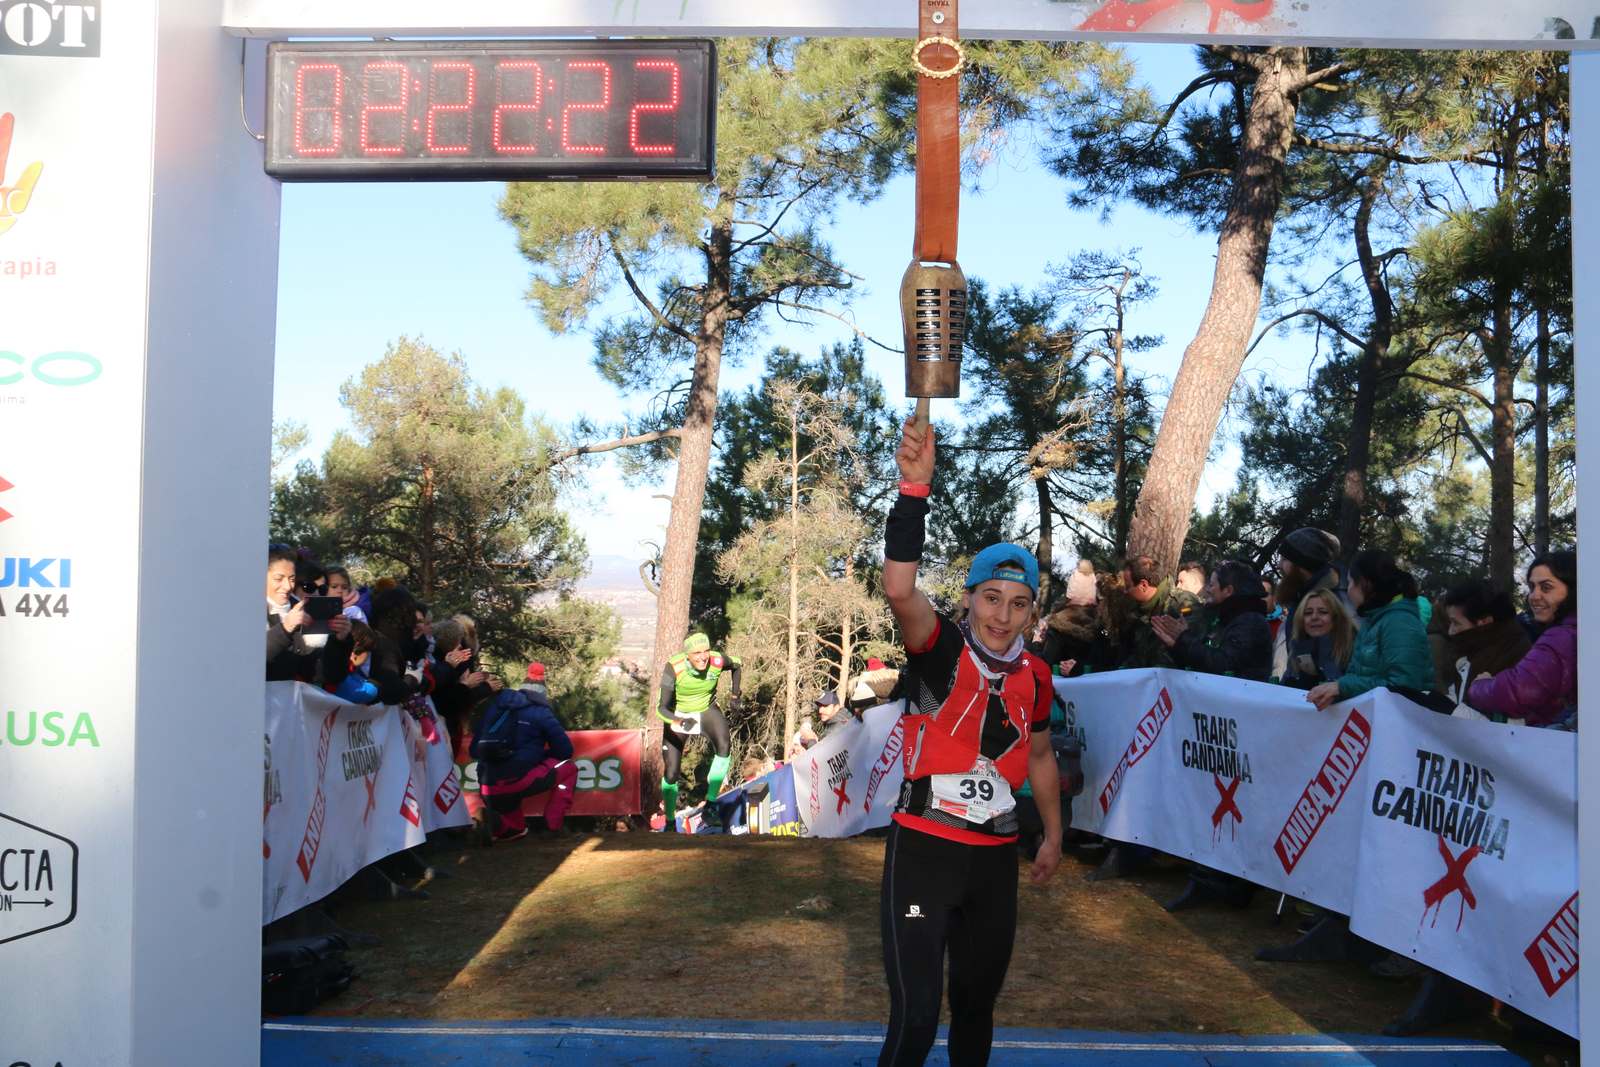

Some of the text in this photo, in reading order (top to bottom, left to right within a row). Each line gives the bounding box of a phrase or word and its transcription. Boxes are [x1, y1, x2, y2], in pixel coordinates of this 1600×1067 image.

[0, 3, 96, 48] OT
[296, 60, 679, 153] 02:22:22
[0, 256, 58, 280] apia
[15, 592, 70, 618] 4X4
[0, 711, 101, 748] USA
[1192, 712, 1239, 750] TRANS
[1182, 739, 1253, 785] CANDAMIA
[1415, 748, 1496, 811] TRANS
[959, 779, 994, 802] 39
[1372, 779, 1511, 861] CANDAMIA
